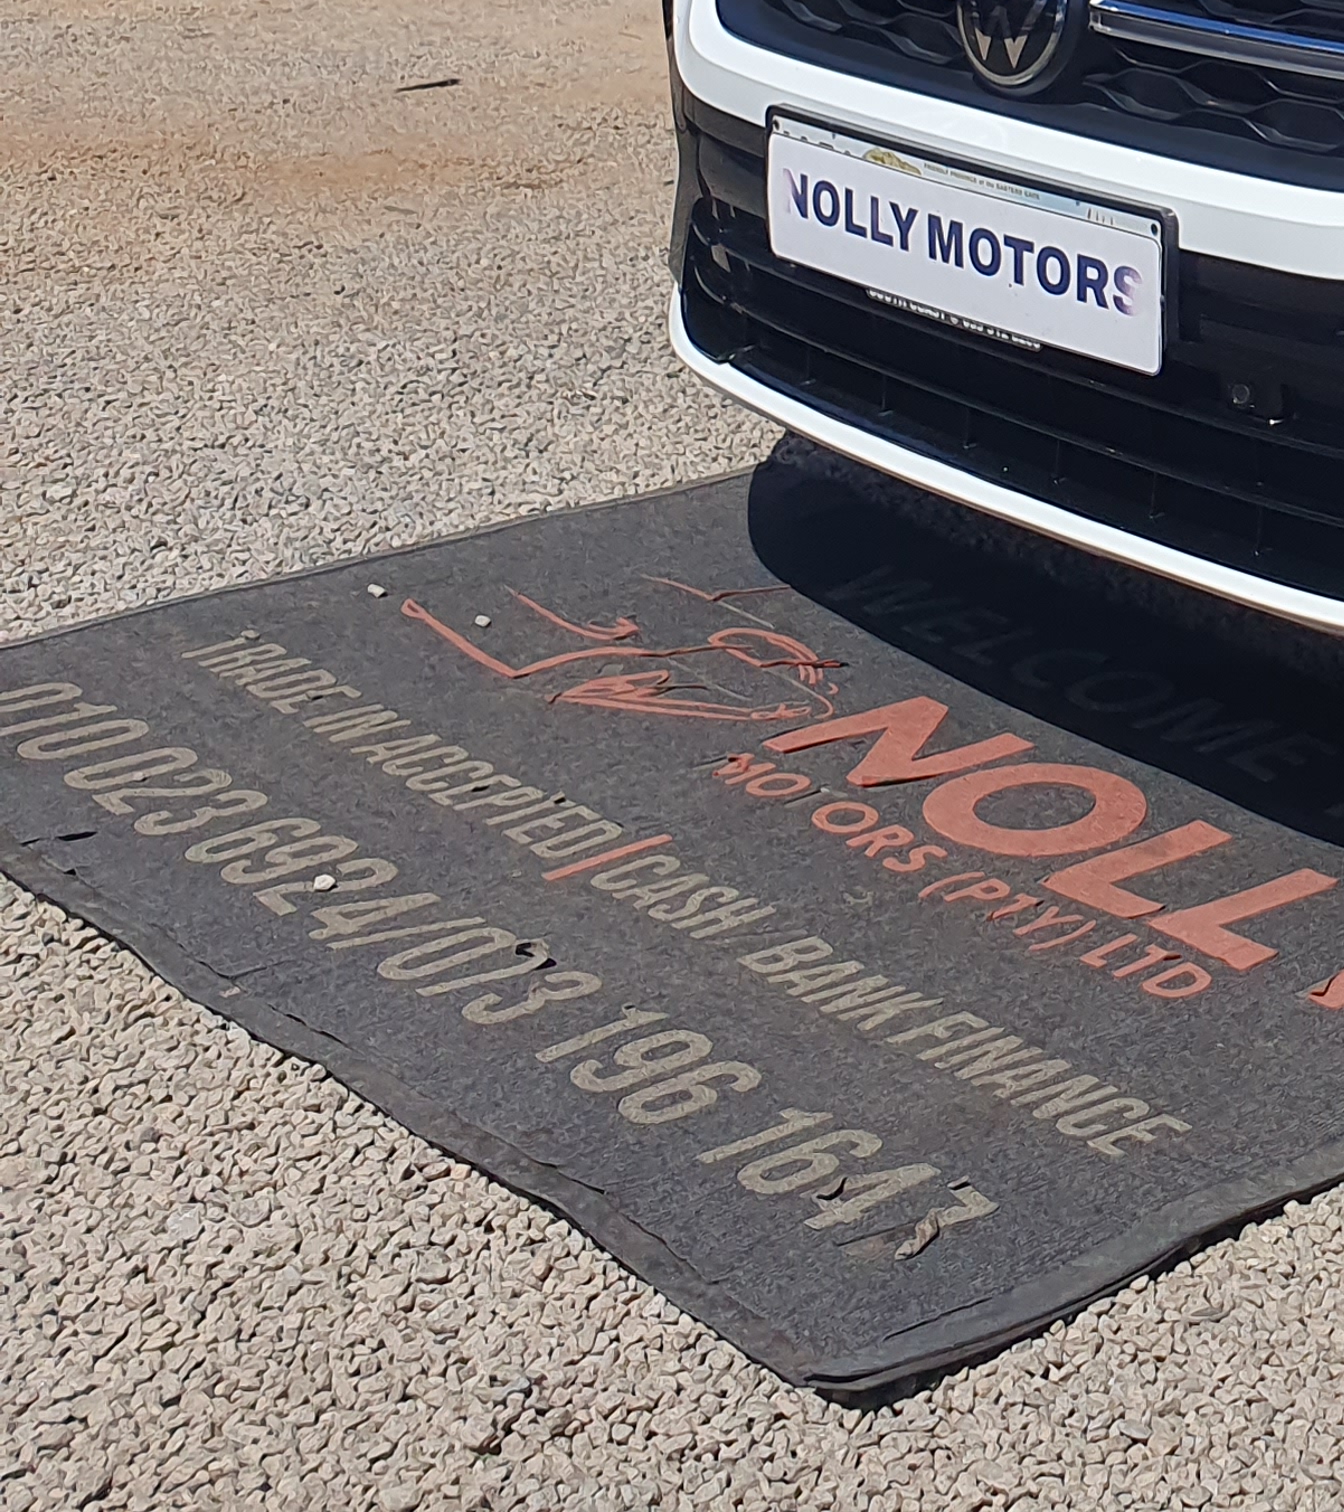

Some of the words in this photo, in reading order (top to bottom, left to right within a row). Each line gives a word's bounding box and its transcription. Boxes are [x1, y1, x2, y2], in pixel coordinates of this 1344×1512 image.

[782, 168, 919, 252] NOLLY
[927, 213, 1144, 316] MOTORS
[825, 564, 1335, 782] WELCOME
[63, 747, 269, 836] 023
[535, 1004, 762, 1124] 196
[181, 630, 362, 714] TRADE
[304, 704, 411, 743] IN
[736, 935, 944, 1032] BANK
[885, 1010, 1193, 1157] FINANCE
[918, 871, 1096, 952] (PTY)
[1080, 933, 1212, 998] LTD
